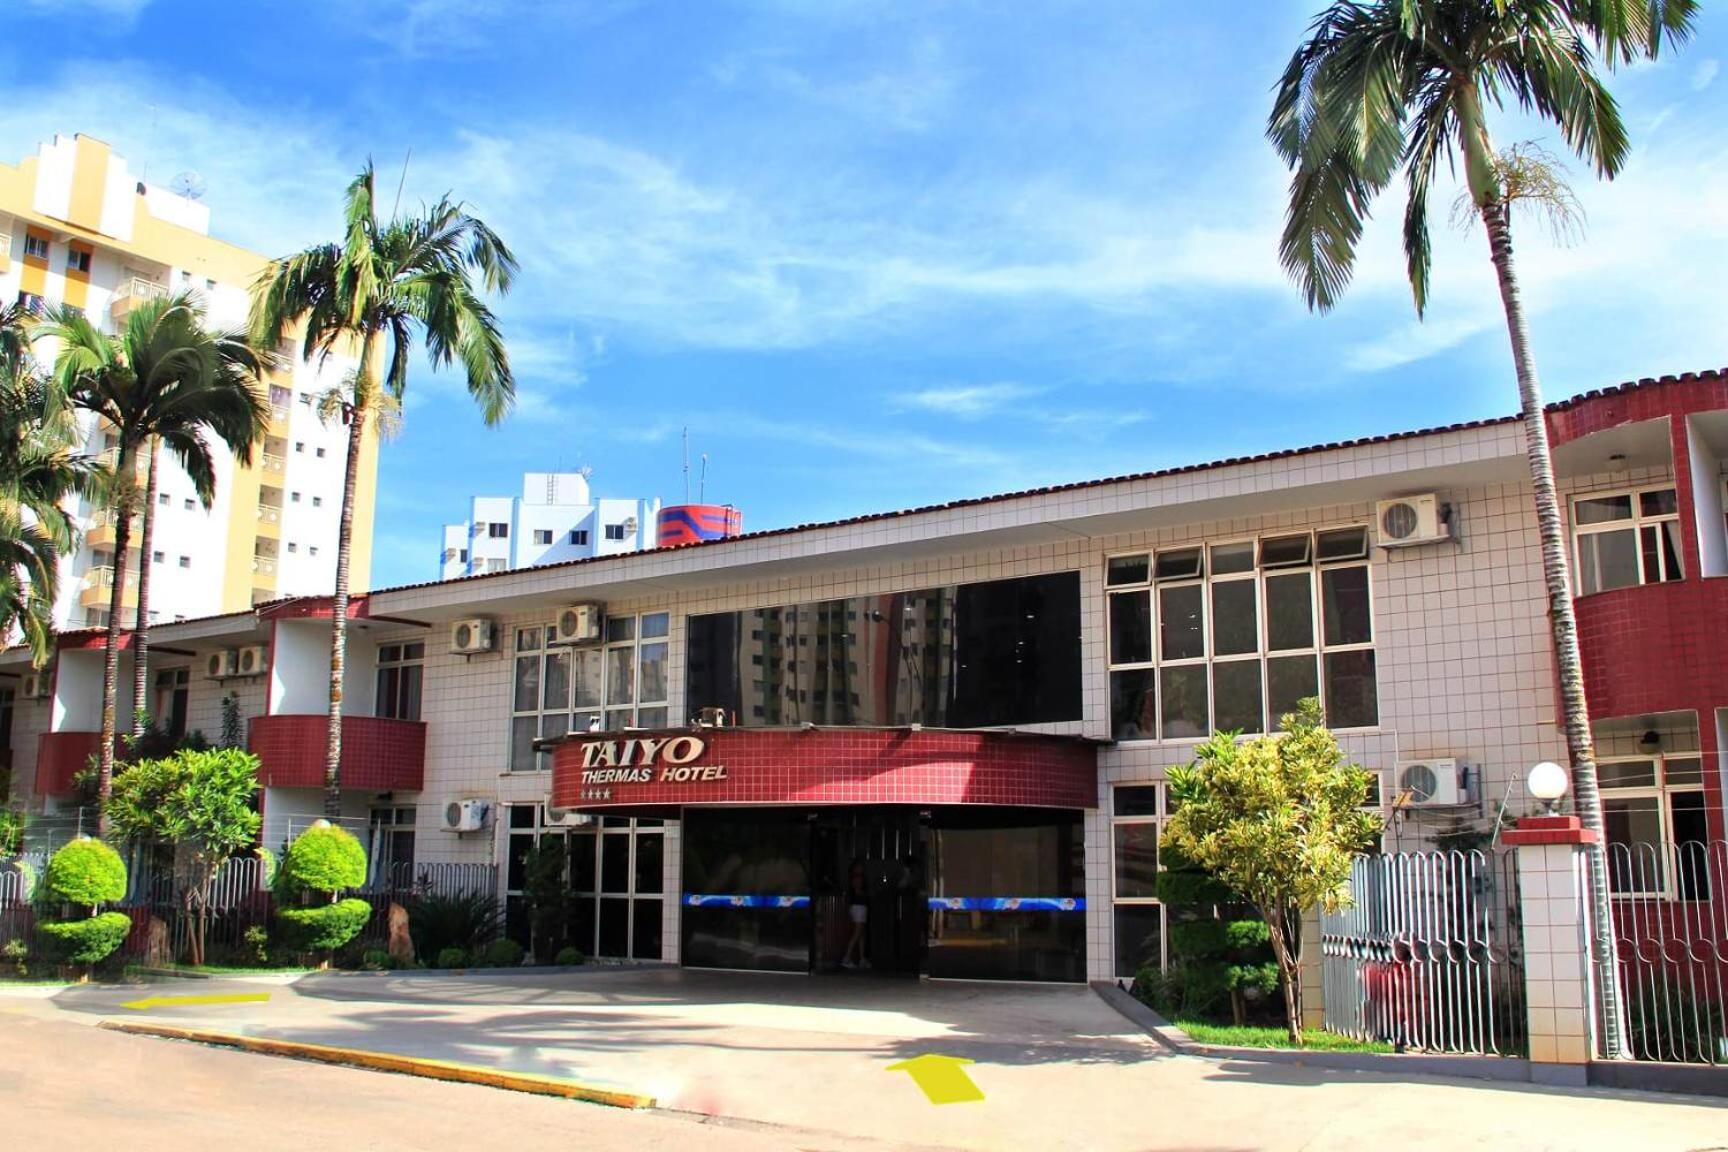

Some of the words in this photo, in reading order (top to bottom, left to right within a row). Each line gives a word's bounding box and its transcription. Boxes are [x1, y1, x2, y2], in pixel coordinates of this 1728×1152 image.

[580, 736, 705, 768] TAIYO
[581, 768, 652, 785] THERMAS
[660, 765, 728, 782] HOTEL
